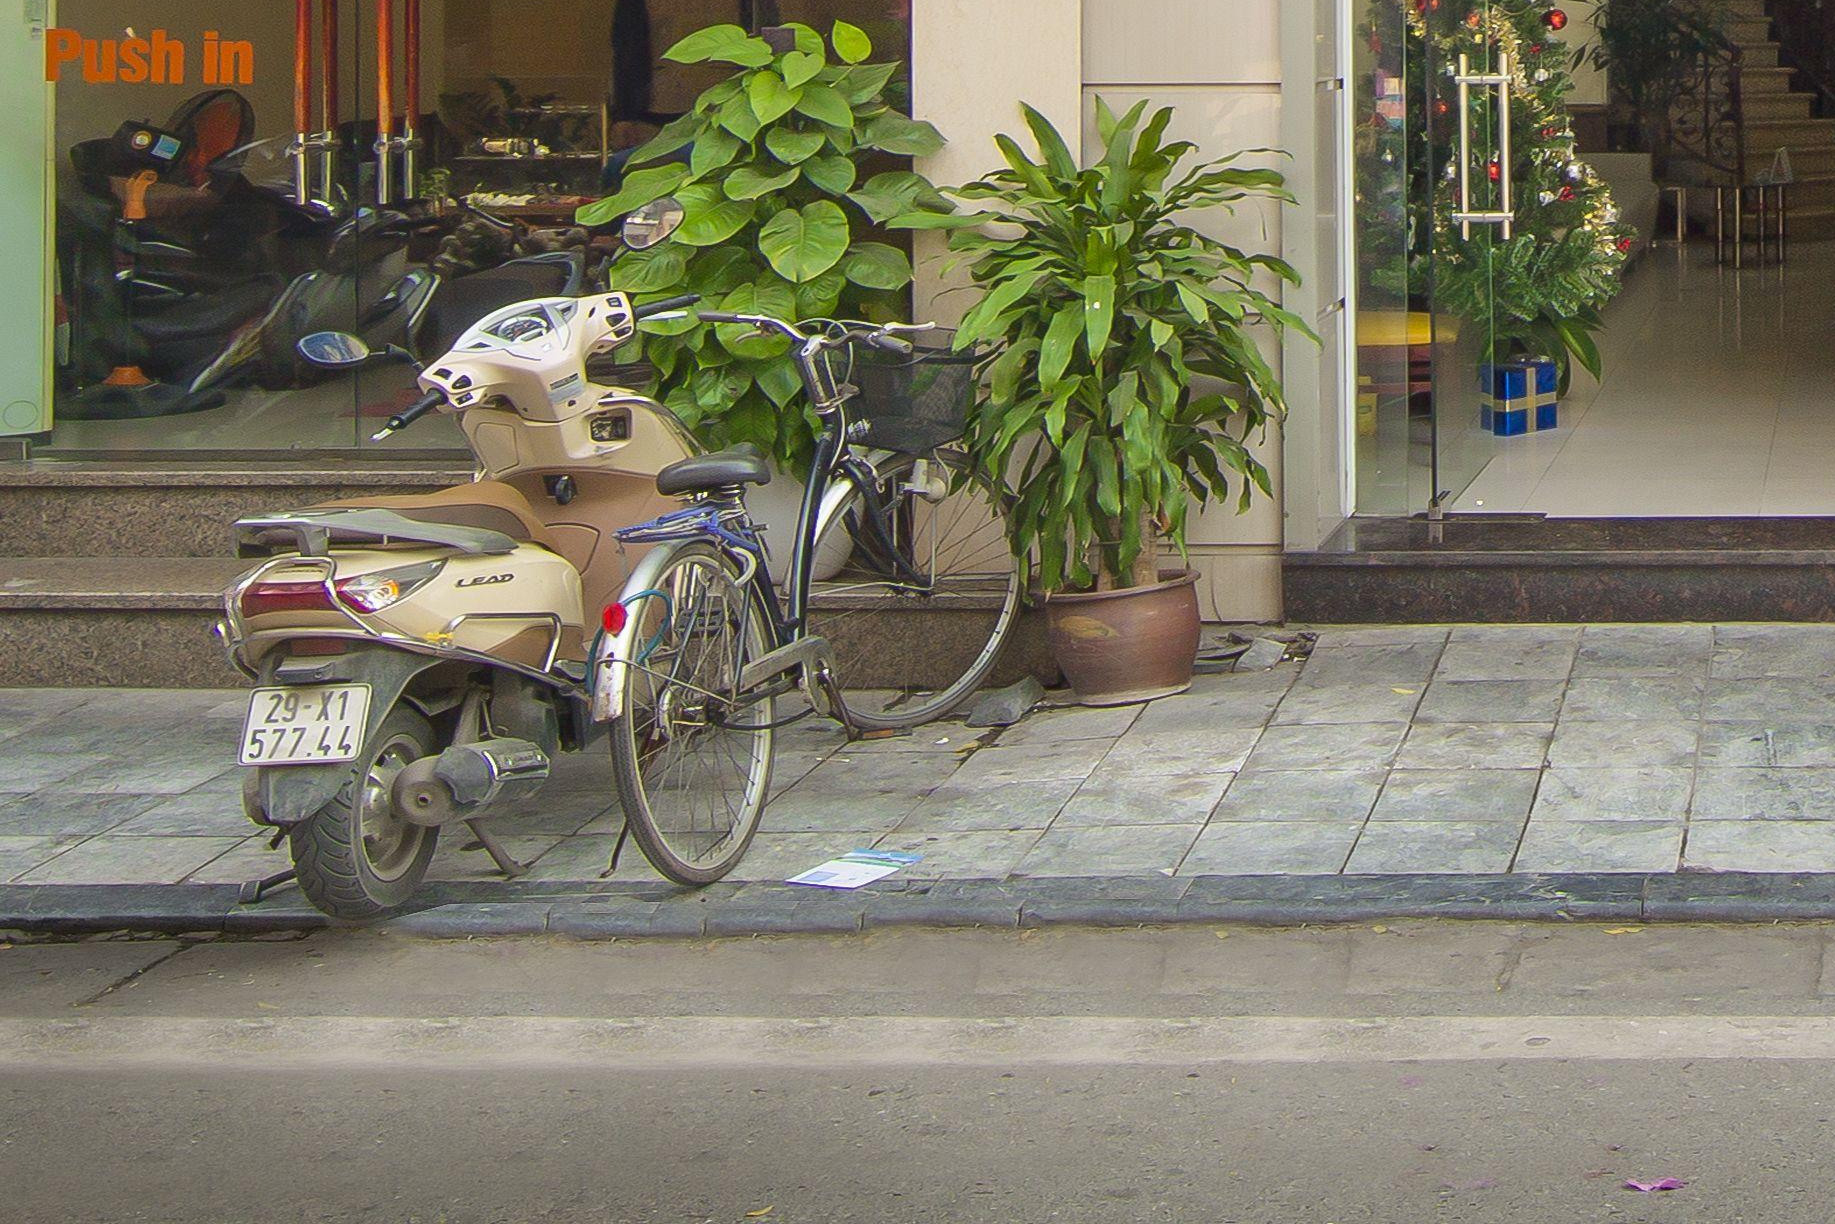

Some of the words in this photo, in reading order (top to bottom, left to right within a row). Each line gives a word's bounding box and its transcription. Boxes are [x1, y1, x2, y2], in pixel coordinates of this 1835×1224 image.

[45, 28, 186, 85] Push
[202, 30, 254, 85] in
[455, 573, 516, 588] LEAD
[264, 690, 351, 725] 29-X1
[249, 726, 354, 760] 577.44
